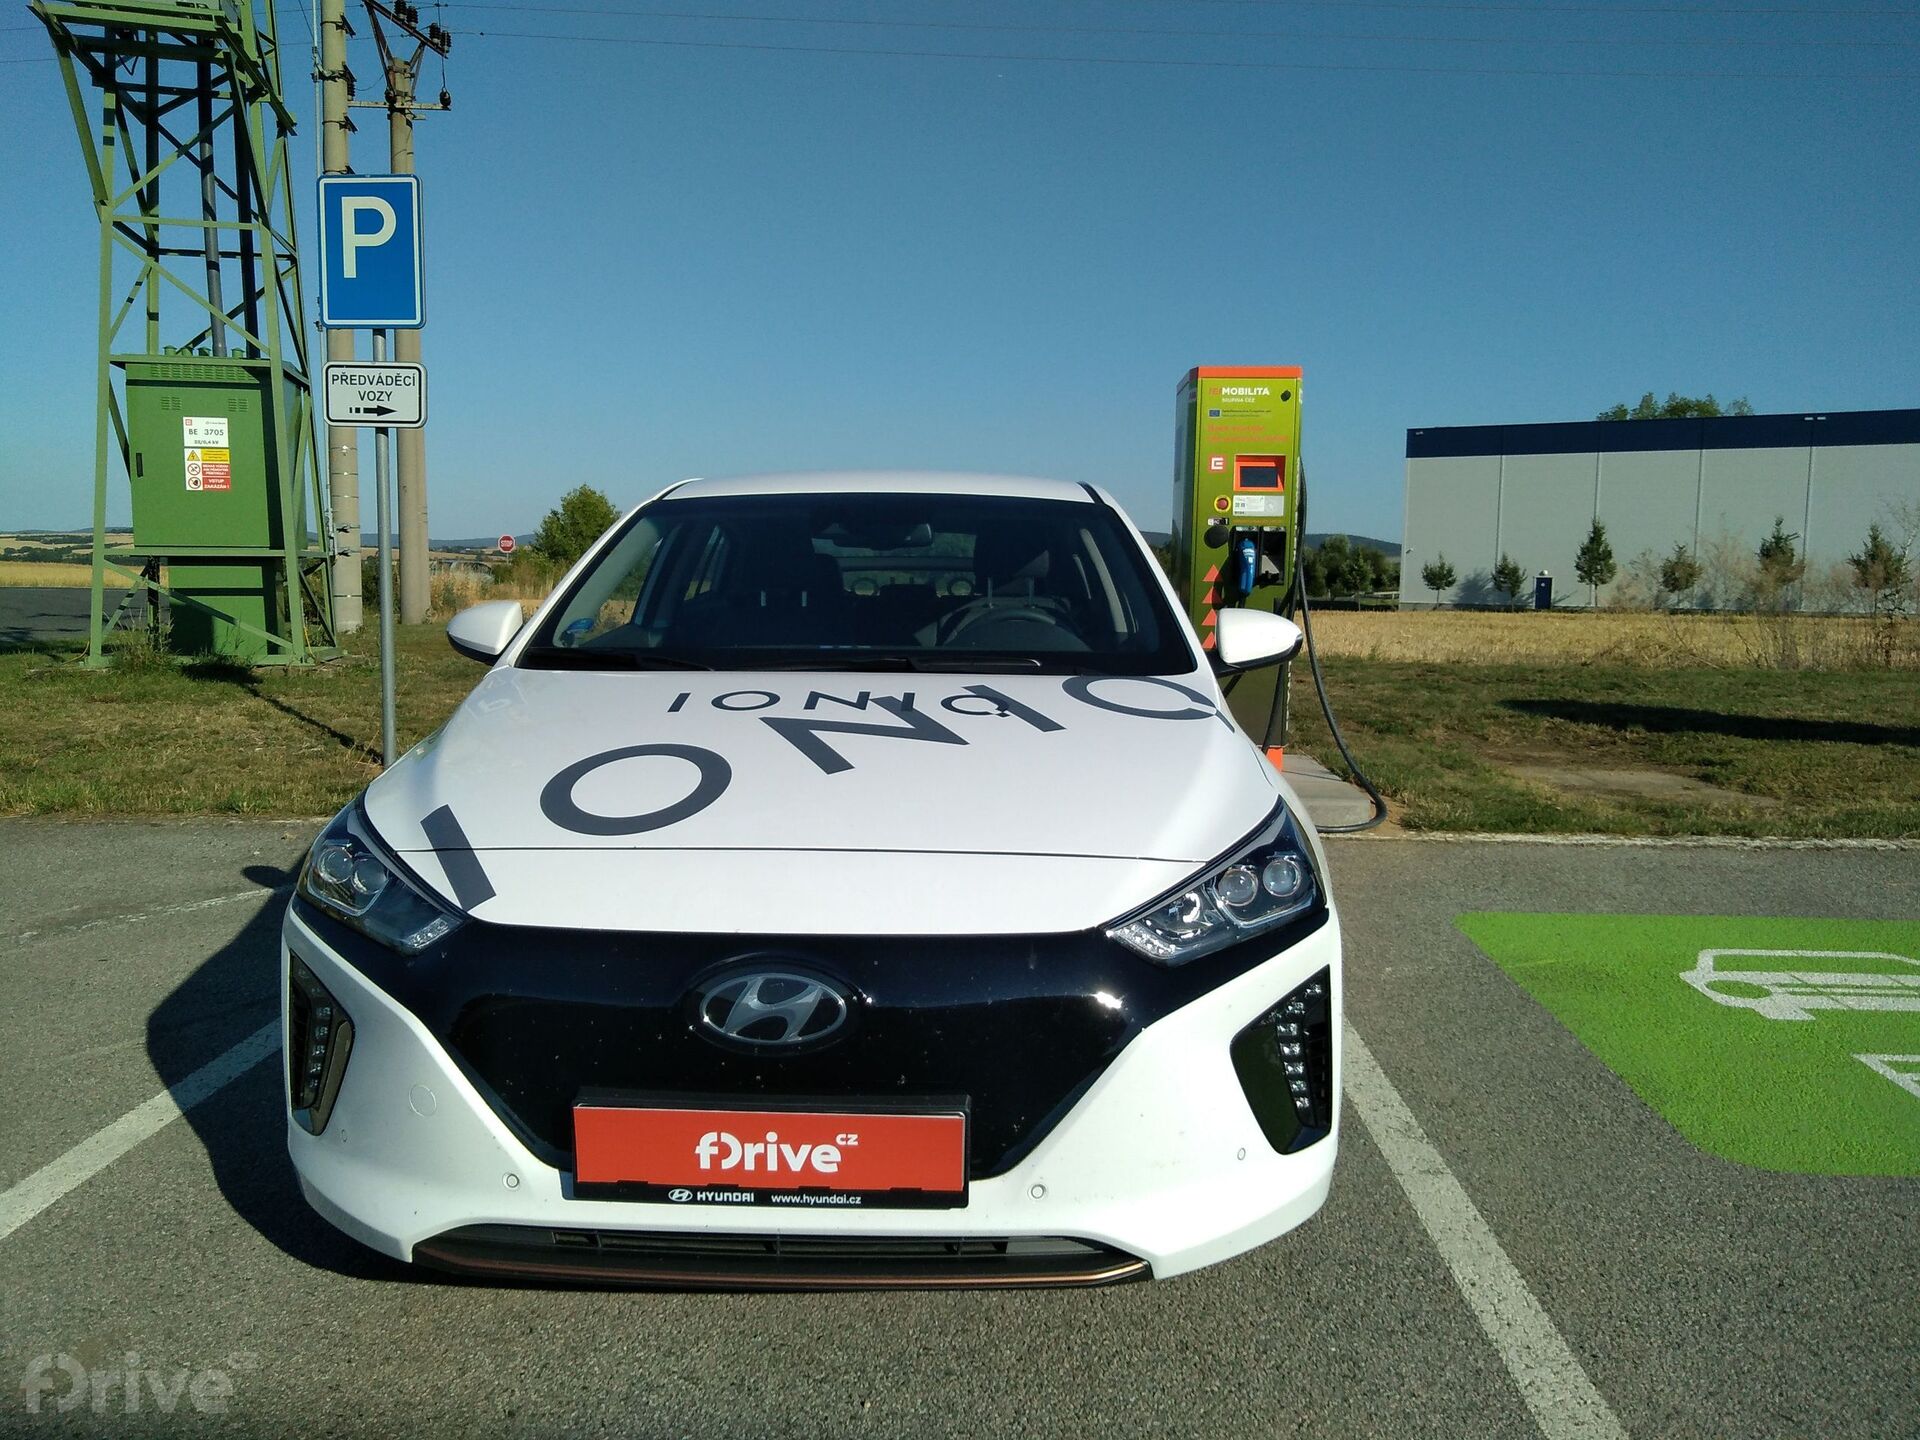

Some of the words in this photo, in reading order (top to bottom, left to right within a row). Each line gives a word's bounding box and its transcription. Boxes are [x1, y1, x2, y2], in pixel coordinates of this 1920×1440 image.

[341, 196, 397, 279] P
[331, 371, 416, 387] PŘEDVÁDĚCÍ
[358, 390, 393, 402] VOZY
[1221, 387, 1270, 396] MOBILITA
[500, 540, 513, 548] STOP
[667, 690, 1010, 717] IONIQ
[696, 1190, 755, 1203] HYUNDAI
[771, 1191, 862, 1206] www.hyundai.cz
